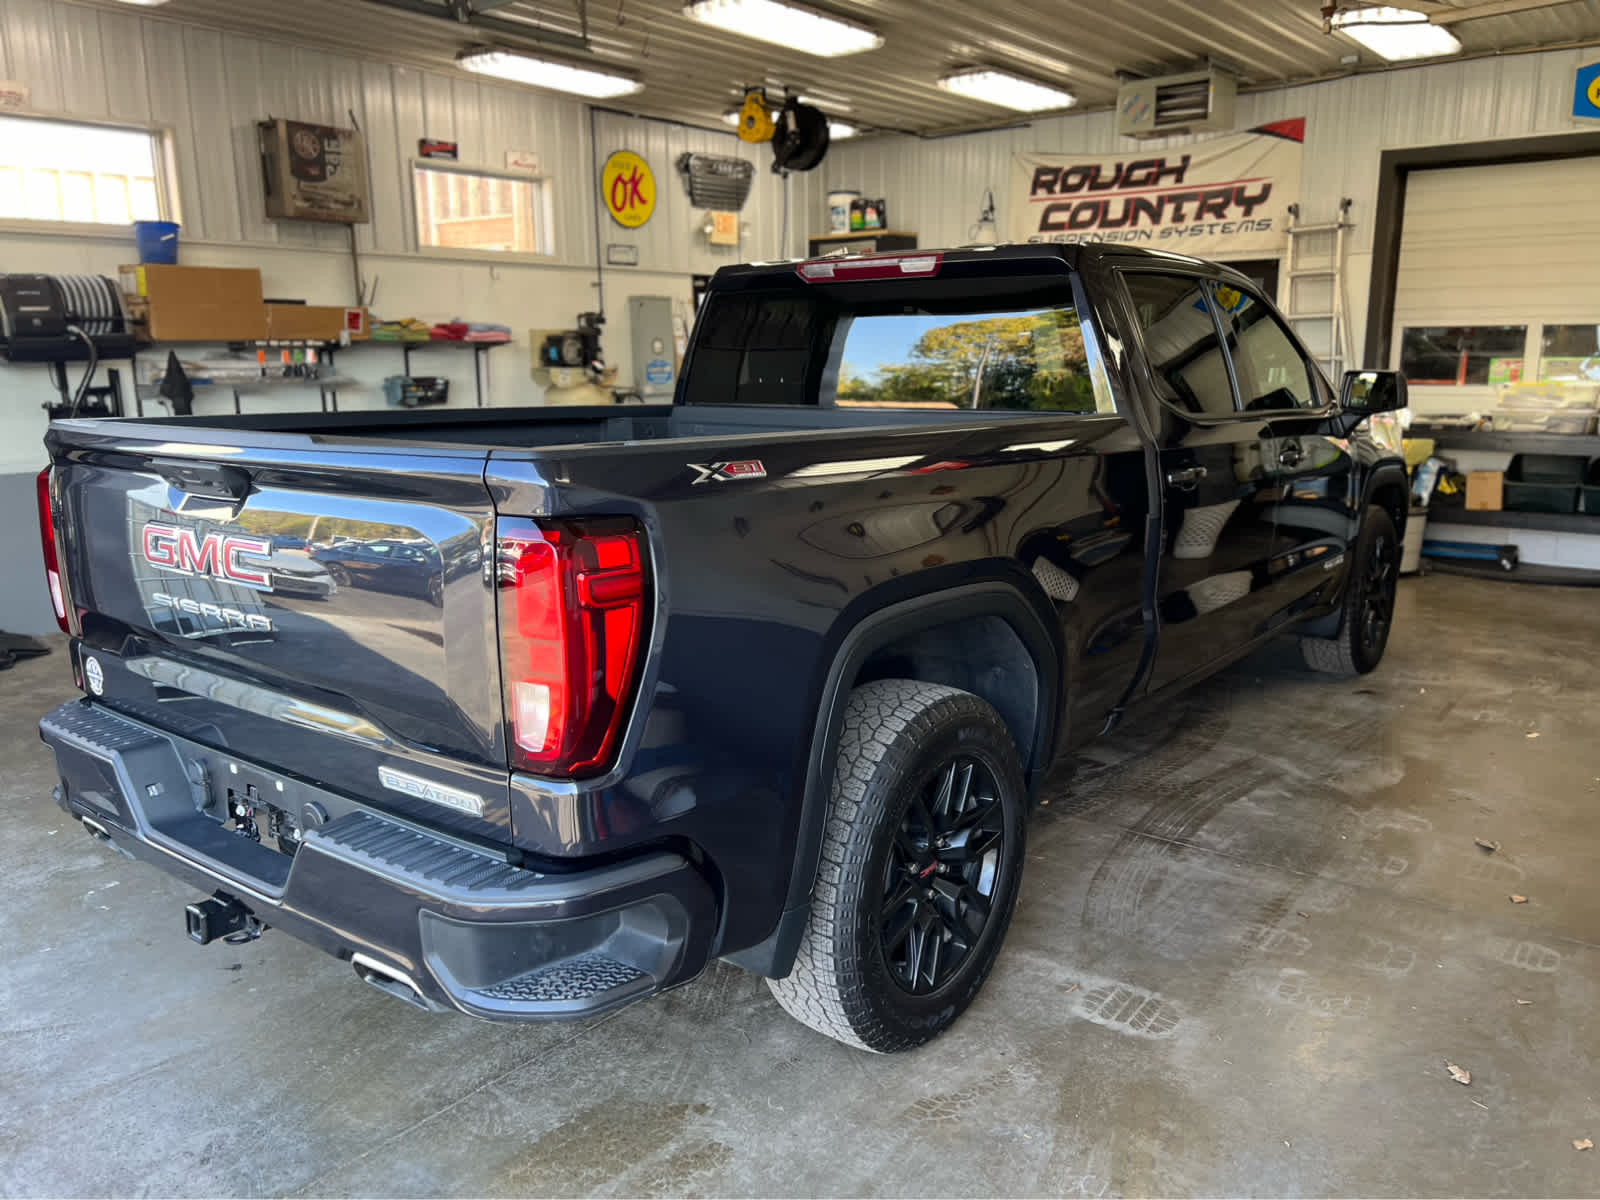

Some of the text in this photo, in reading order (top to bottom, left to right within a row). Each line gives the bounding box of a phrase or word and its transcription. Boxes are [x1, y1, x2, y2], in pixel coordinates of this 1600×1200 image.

[611, 165, 648, 212] OK
[1030, 155, 1191, 196] ROUGH
[1038, 183, 1273, 233] COUNTRY
[1158, 218, 1272, 237] SYSTEMS
[143, 522, 273, 592] GMC
[152, 593, 273, 631] SIERRA
[385, 775, 480, 812] ELEVATION
